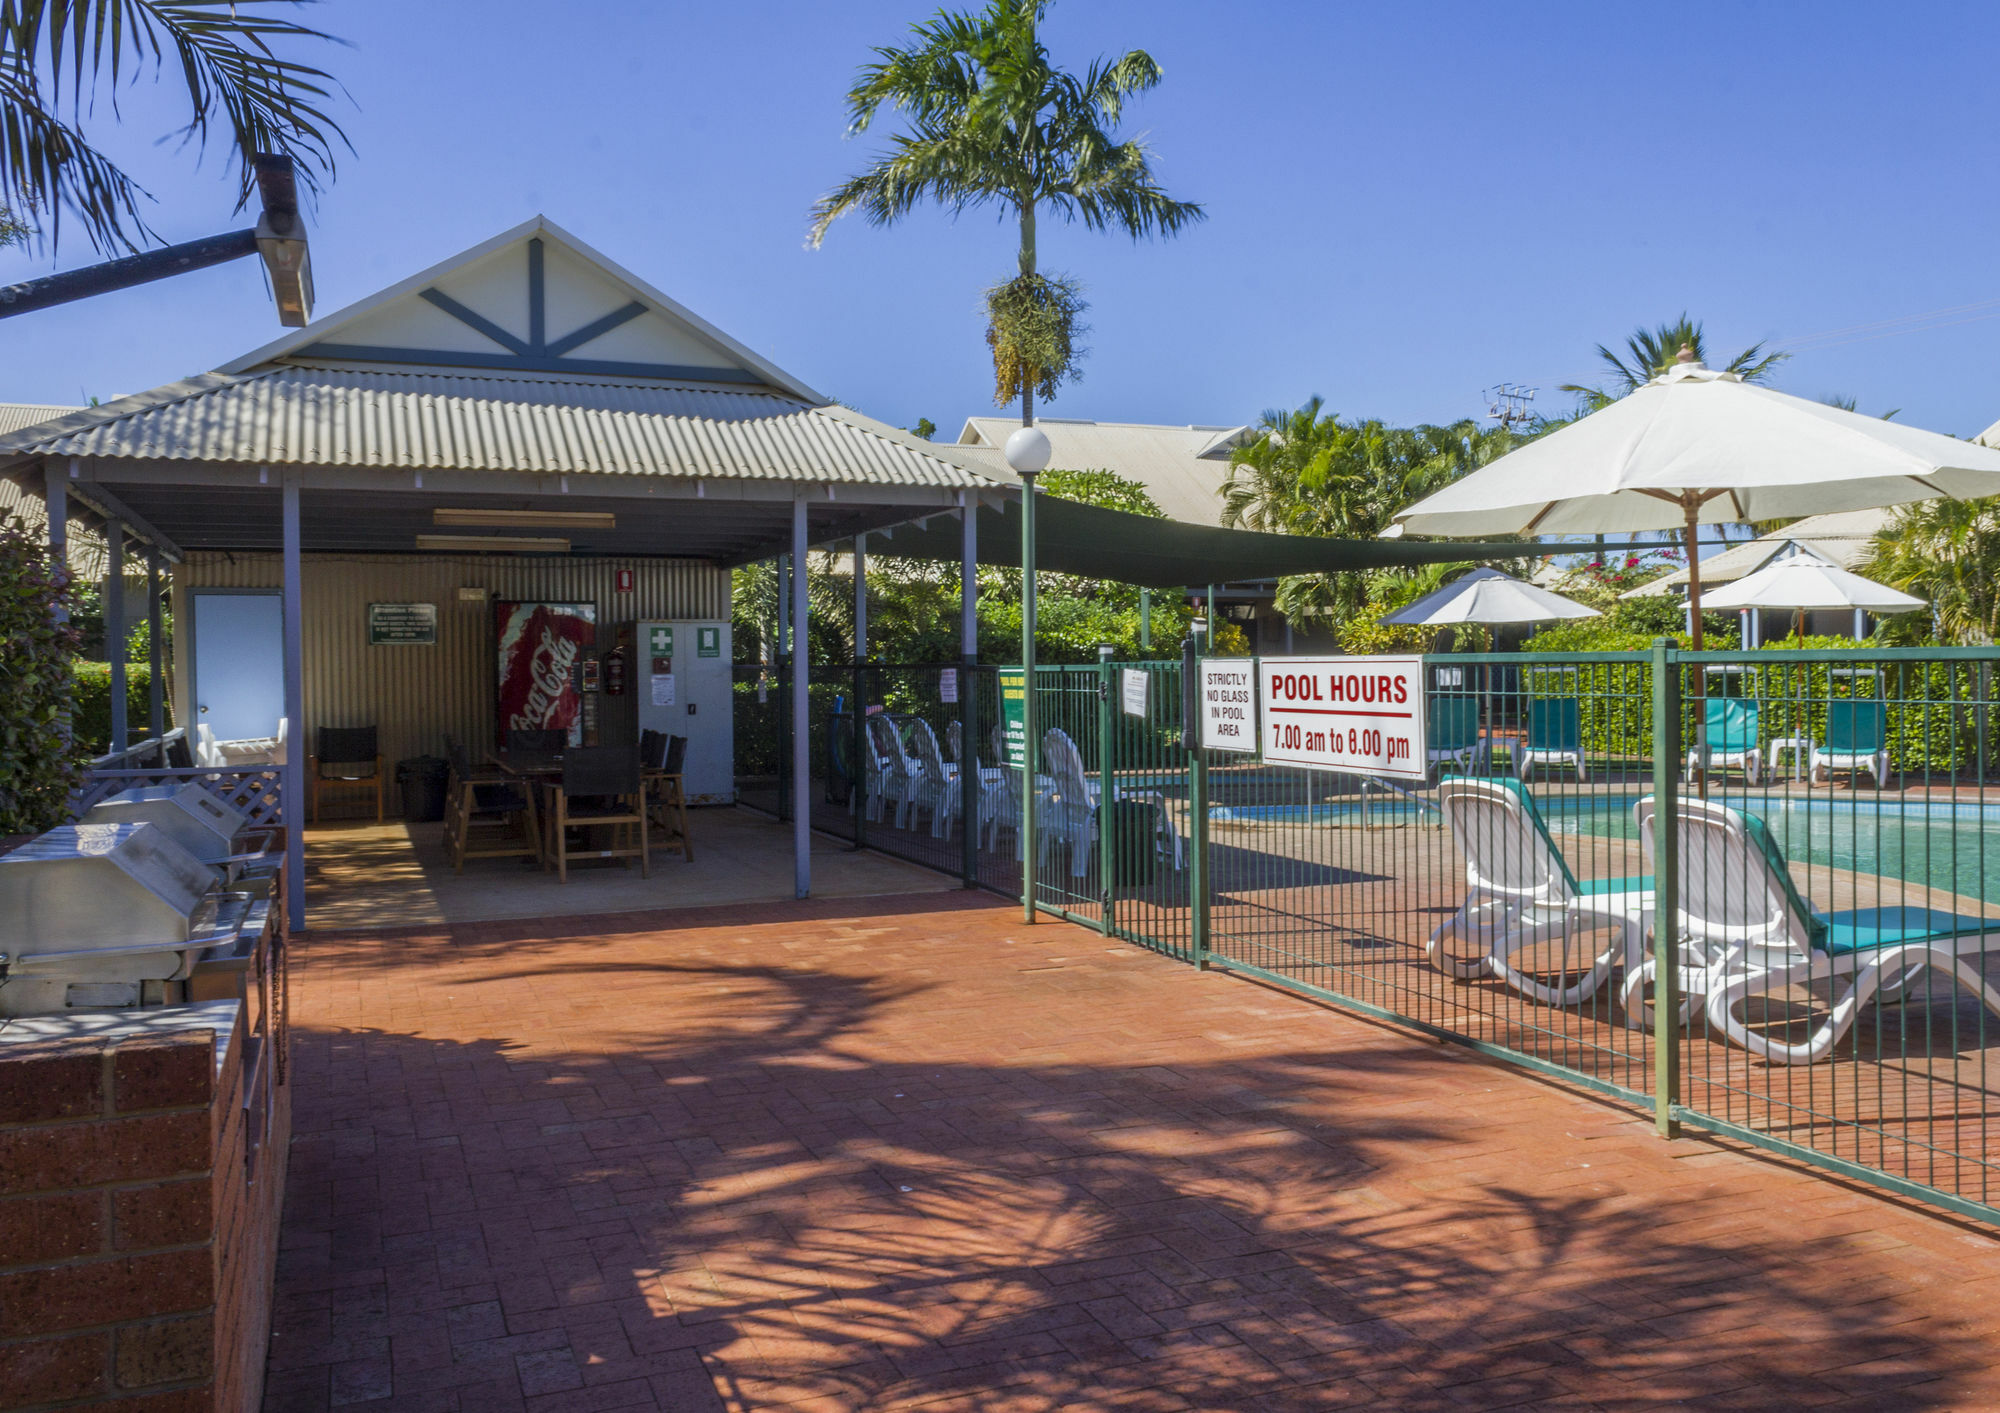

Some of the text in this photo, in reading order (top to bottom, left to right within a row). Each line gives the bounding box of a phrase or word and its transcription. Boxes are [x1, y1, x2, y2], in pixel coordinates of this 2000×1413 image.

[1207, 672, 1247, 686] STRICTLY
[1271, 674, 1408, 704] POOL HOURS
[1207, 689, 1249, 704] NO GLASS
[1211, 706, 1245, 720] IN POOL
[1217, 723, 1240, 737] AREA
[1272, 723, 1410, 764] 7.00 am to 8.00 pm
